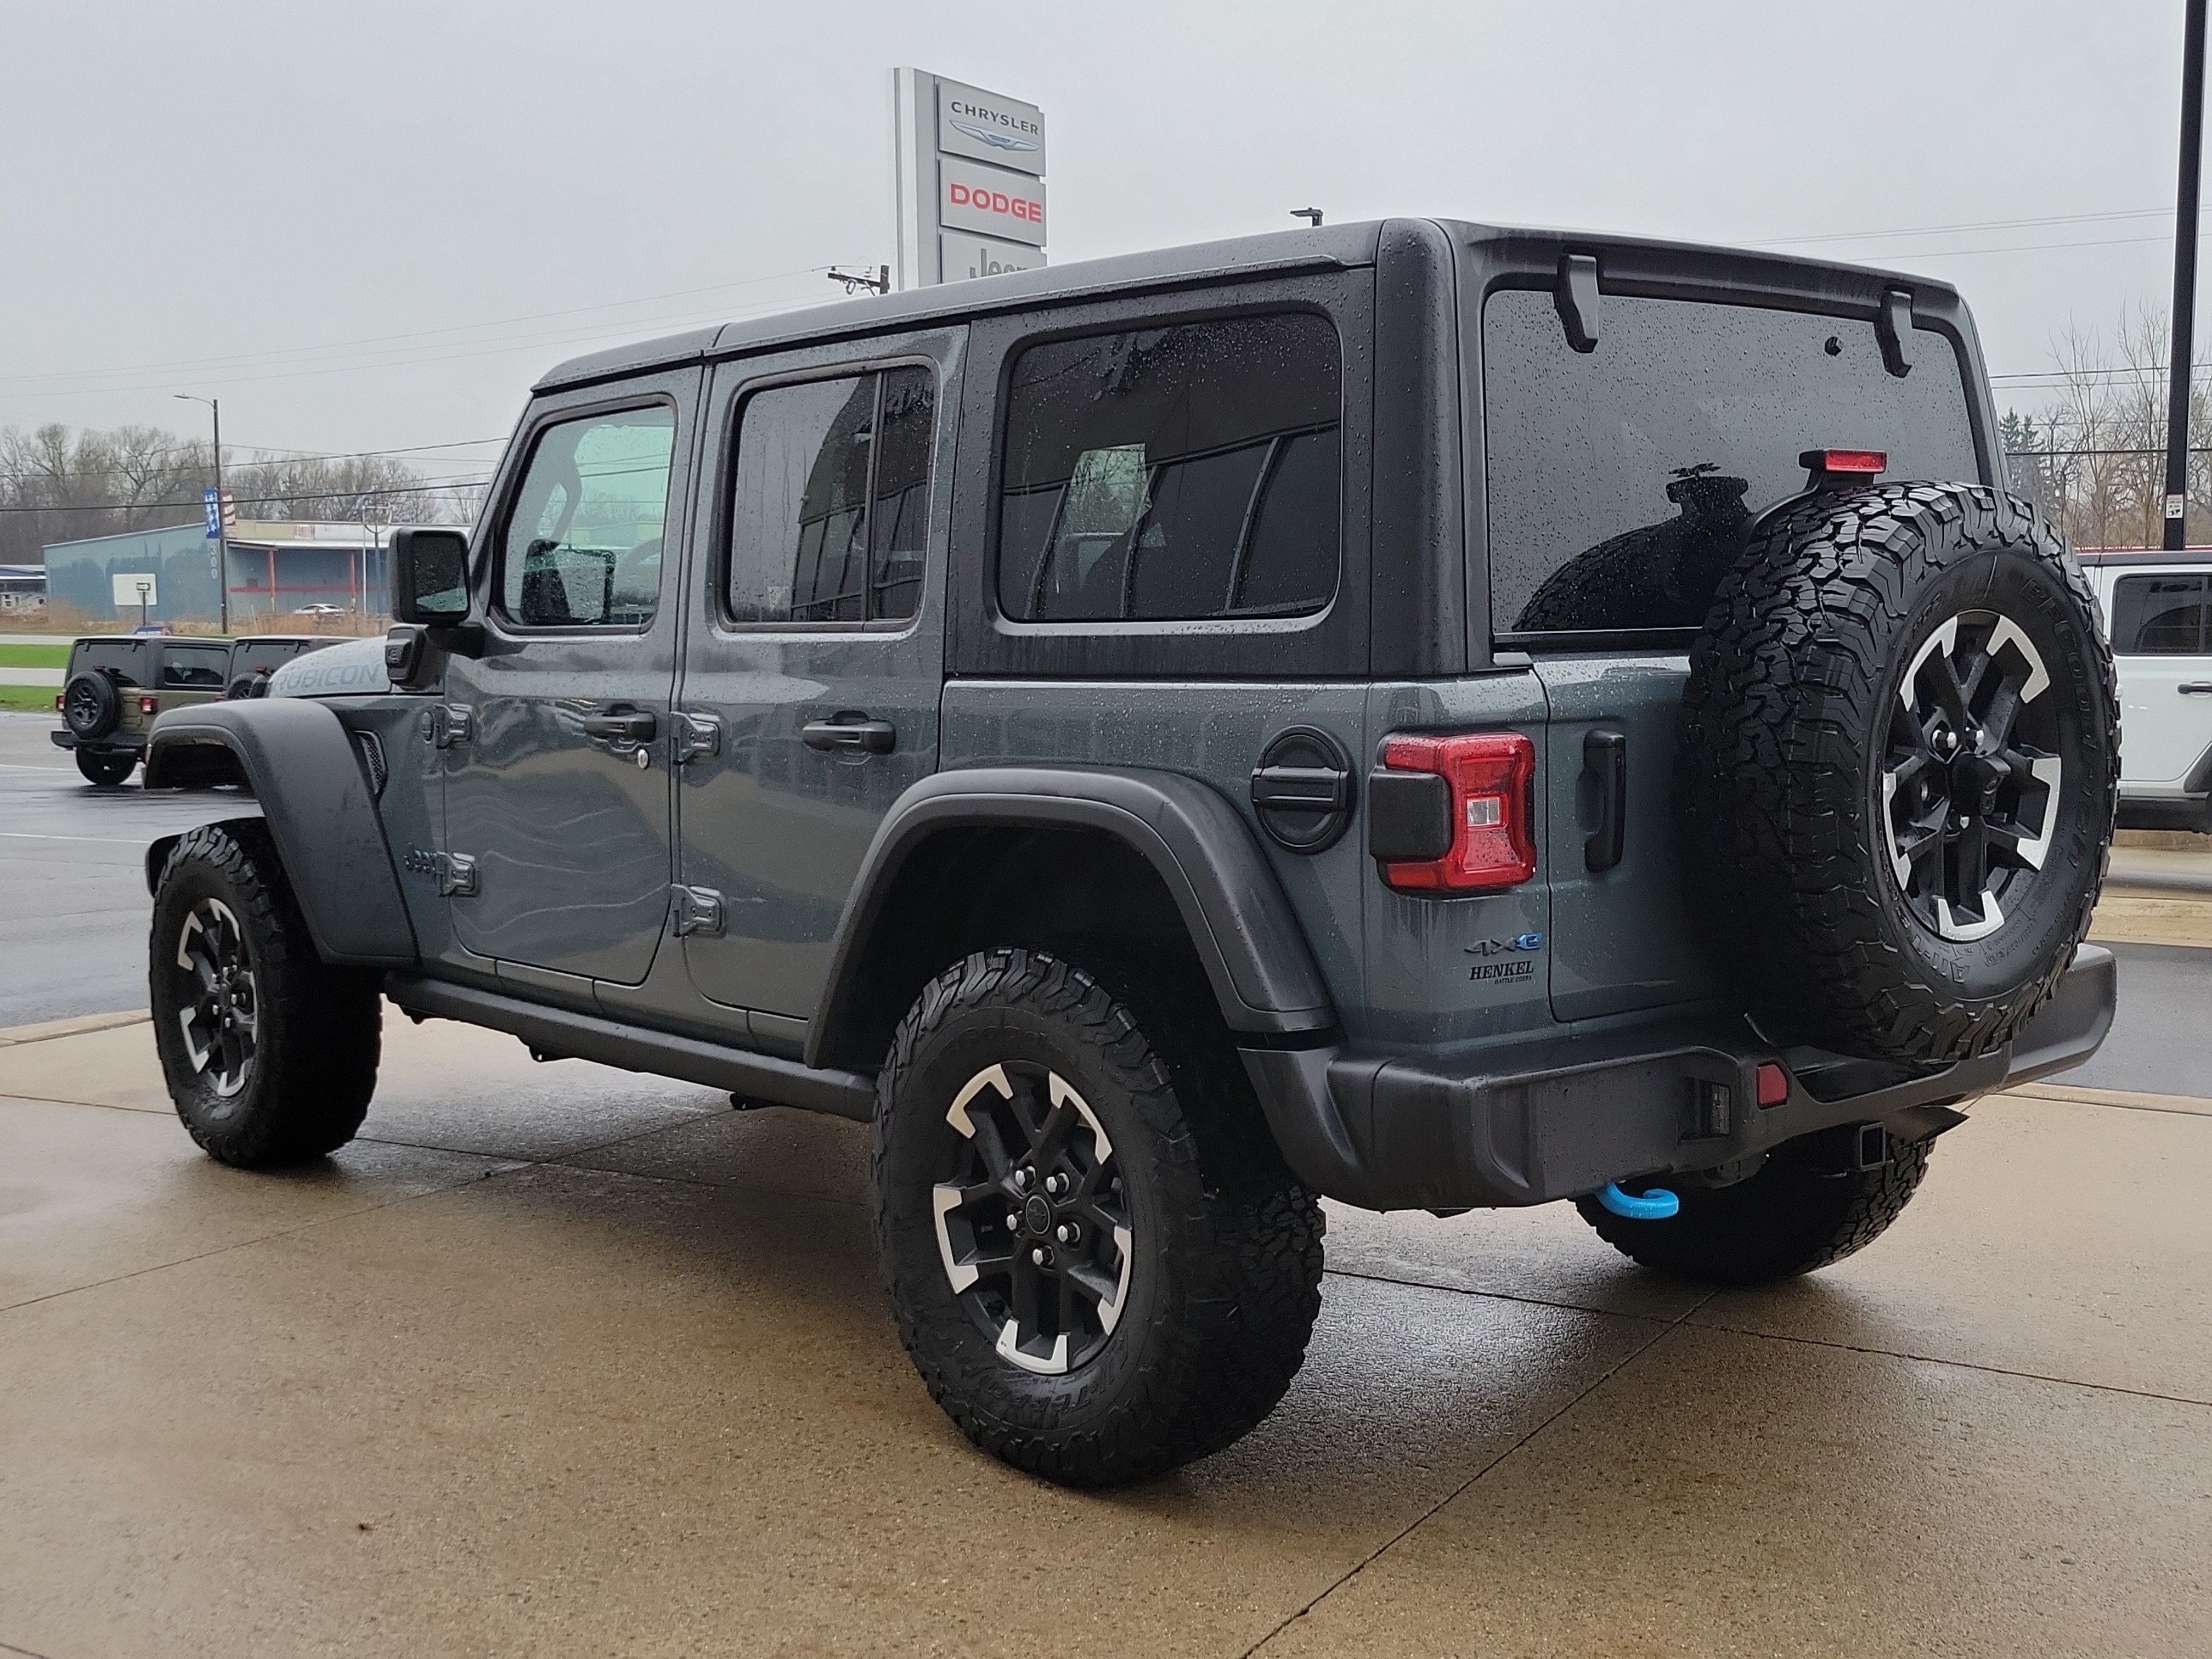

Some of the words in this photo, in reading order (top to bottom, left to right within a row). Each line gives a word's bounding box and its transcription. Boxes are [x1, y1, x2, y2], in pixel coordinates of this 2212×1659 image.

[951, 101, 1039, 135] CHRYSLER
[950, 183, 1042, 223] DODGE
[274, 662, 383, 691] RUBICON
[1470, 961, 1534, 980] HENKEL
